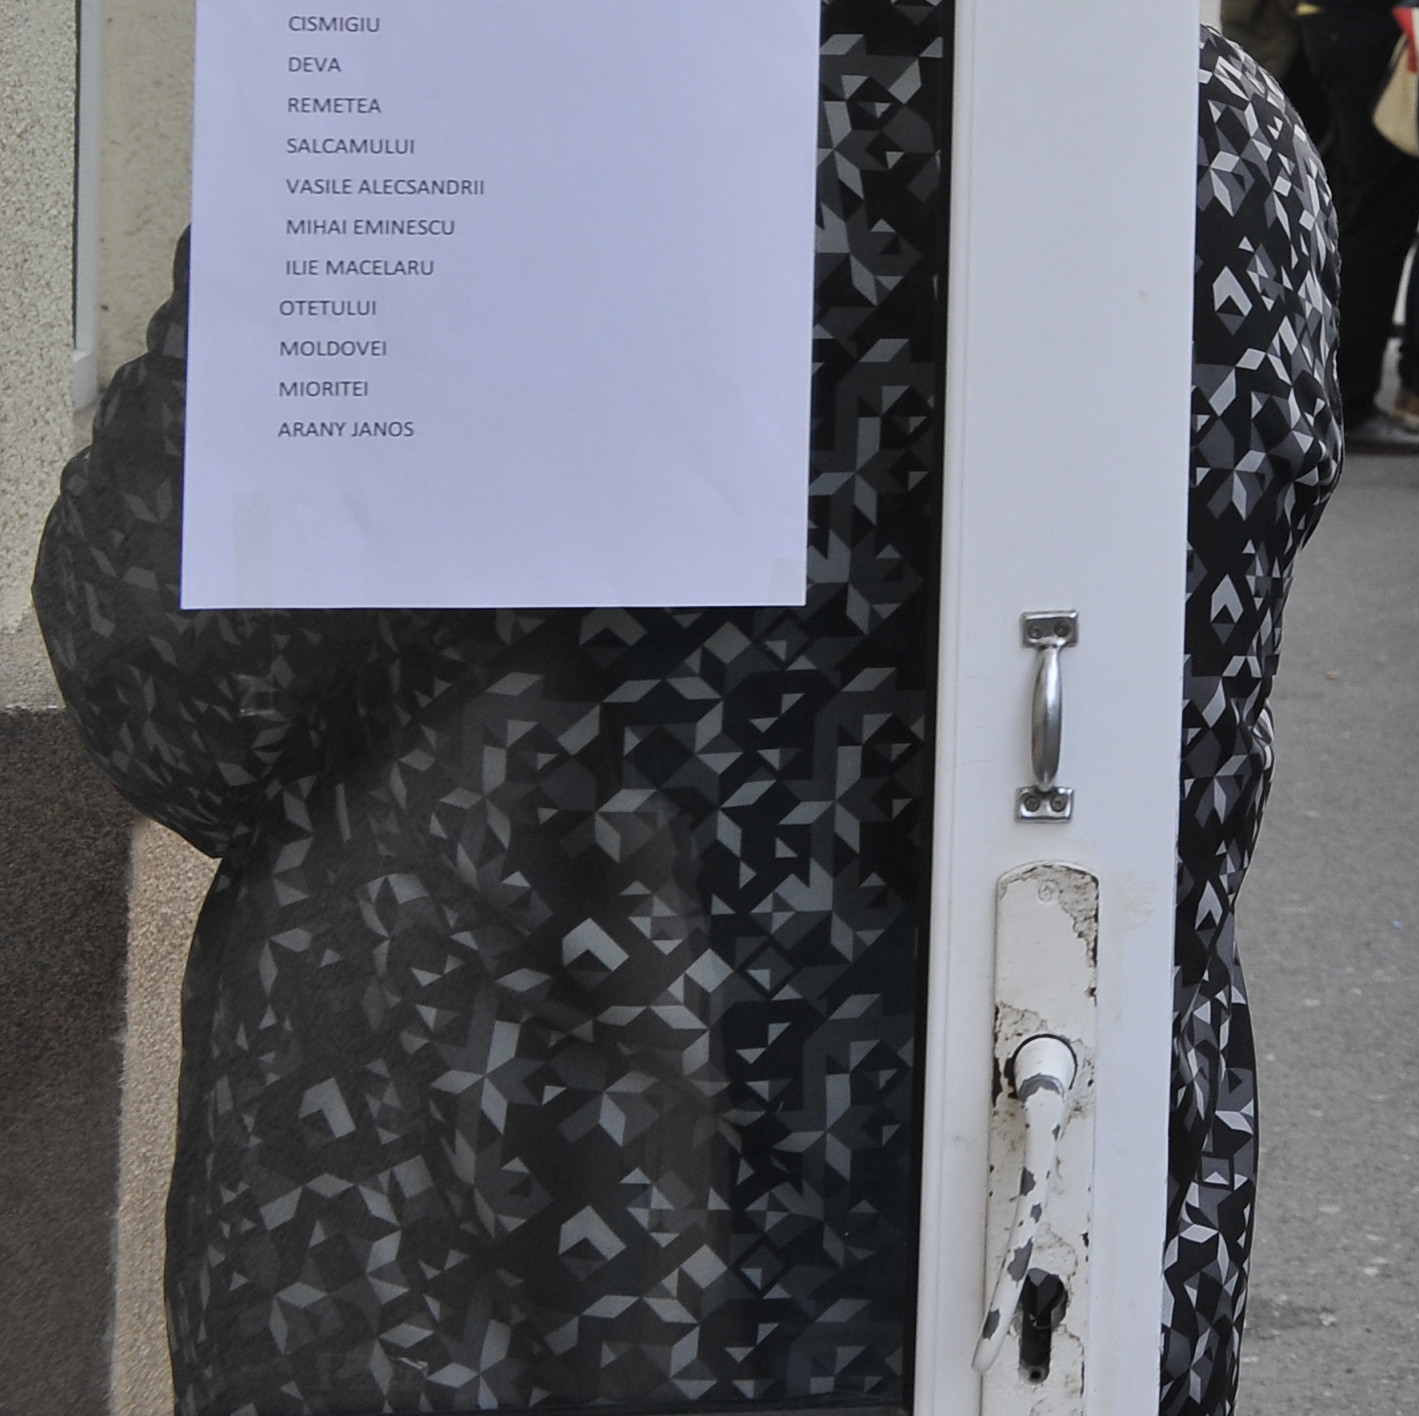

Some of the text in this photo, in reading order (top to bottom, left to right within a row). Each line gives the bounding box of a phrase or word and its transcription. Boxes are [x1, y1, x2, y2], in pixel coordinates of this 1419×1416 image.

[288, 15, 380, 33] CISMIGIU
[288, 56, 342, 73] DEVA
[287, 97, 382, 114] REMETEA
[286, 137, 415, 155] SALCAMULUI
[285, 178, 485, 196] VASILE ALECSANDRII
[286, 219, 455, 236] MIHAI EMINESCU
[285, 259, 435, 276] ILIE MACELARU
[279, 300, 377, 316] OTETULUI
[279, 340, 387, 357] MOLDOVEI
[279, 380, 369, 397] MIORITEI
[277, 421, 415, 438] ARANY JANOS
